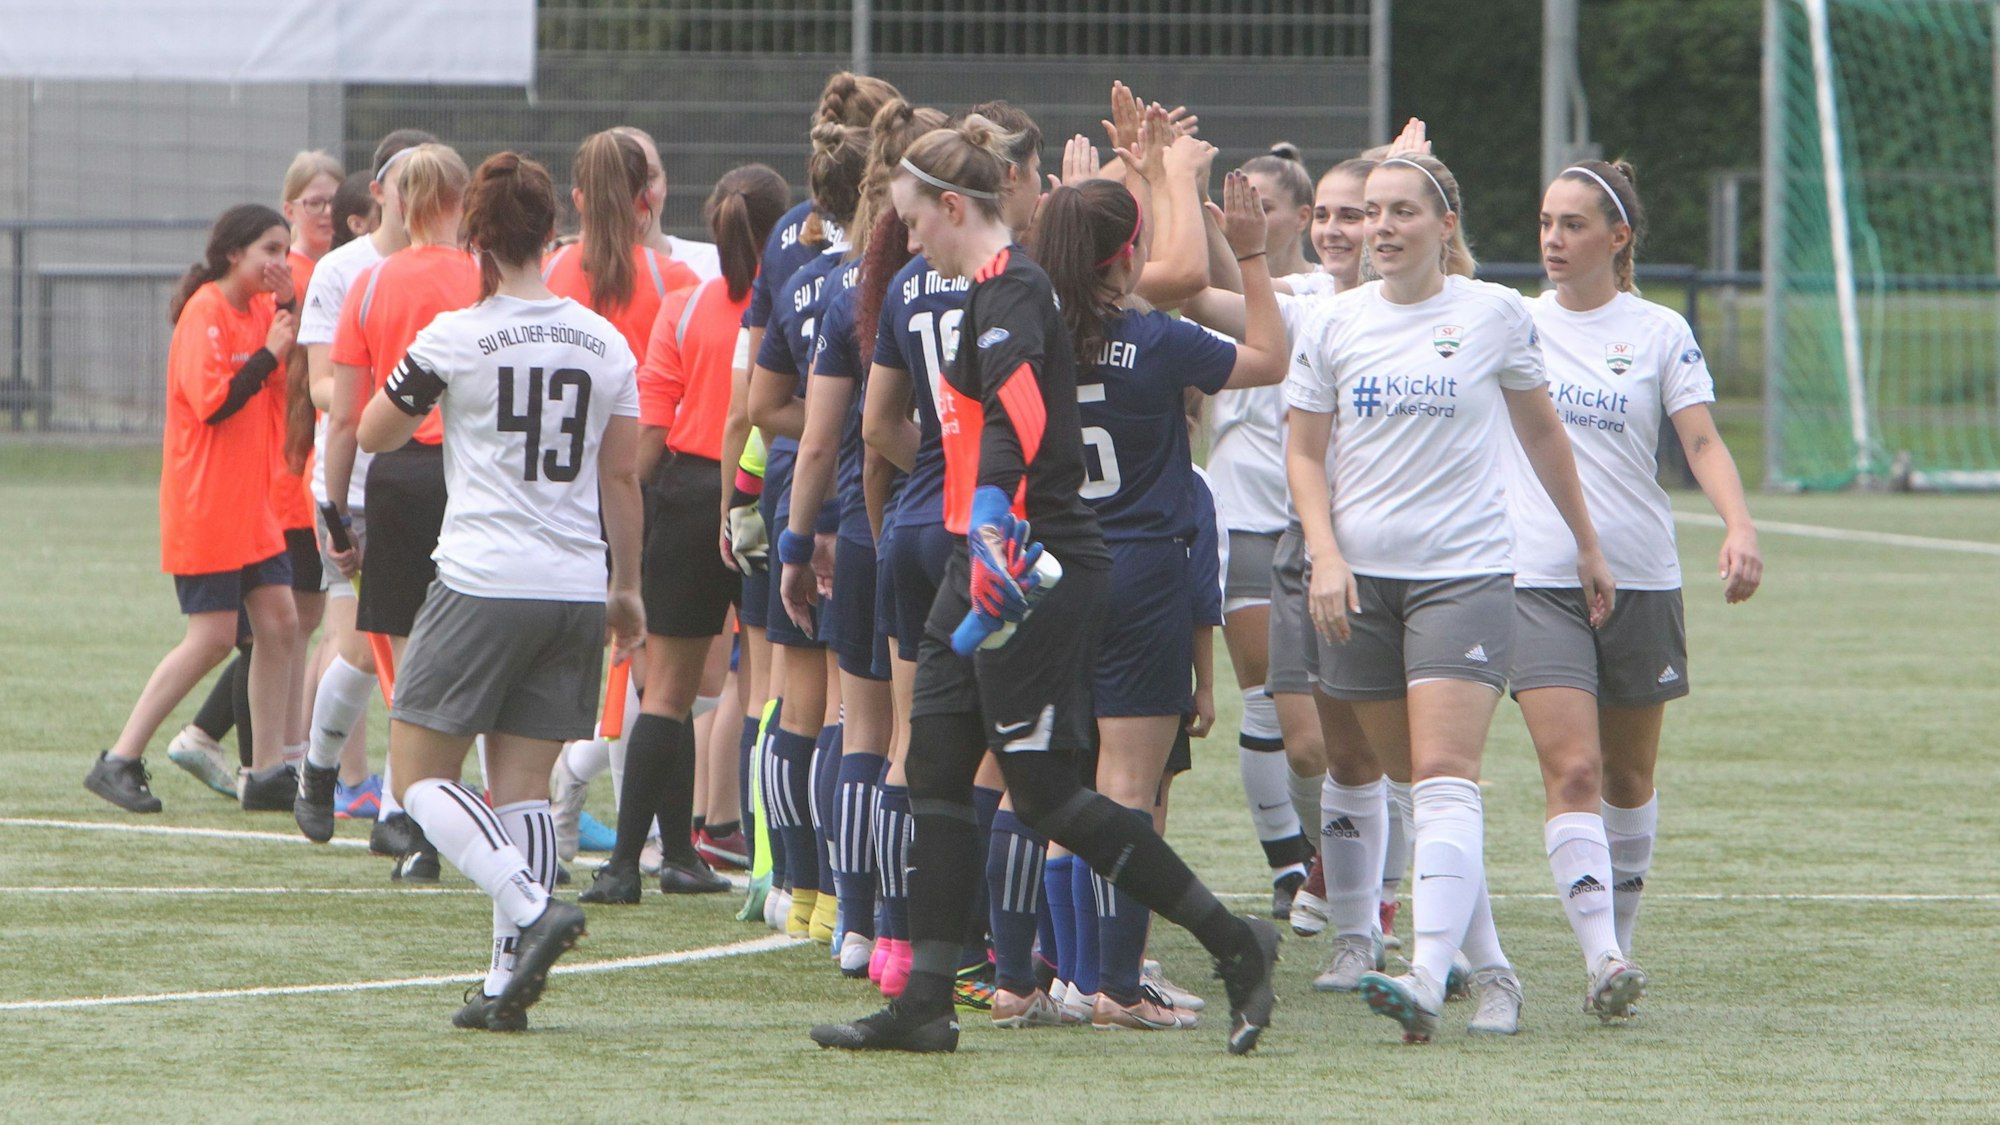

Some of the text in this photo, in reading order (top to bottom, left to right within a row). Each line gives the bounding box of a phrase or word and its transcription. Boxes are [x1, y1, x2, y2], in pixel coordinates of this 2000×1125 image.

[497, 322, 606, 358] ALLNER-BÖDINGEN
[1614, 345, 1628, 353] SV
[1386, 402, 1456, 418] LikeFord
[497, 366, 592, 482] 43
[1569, 881, 1606, 898] adidas
